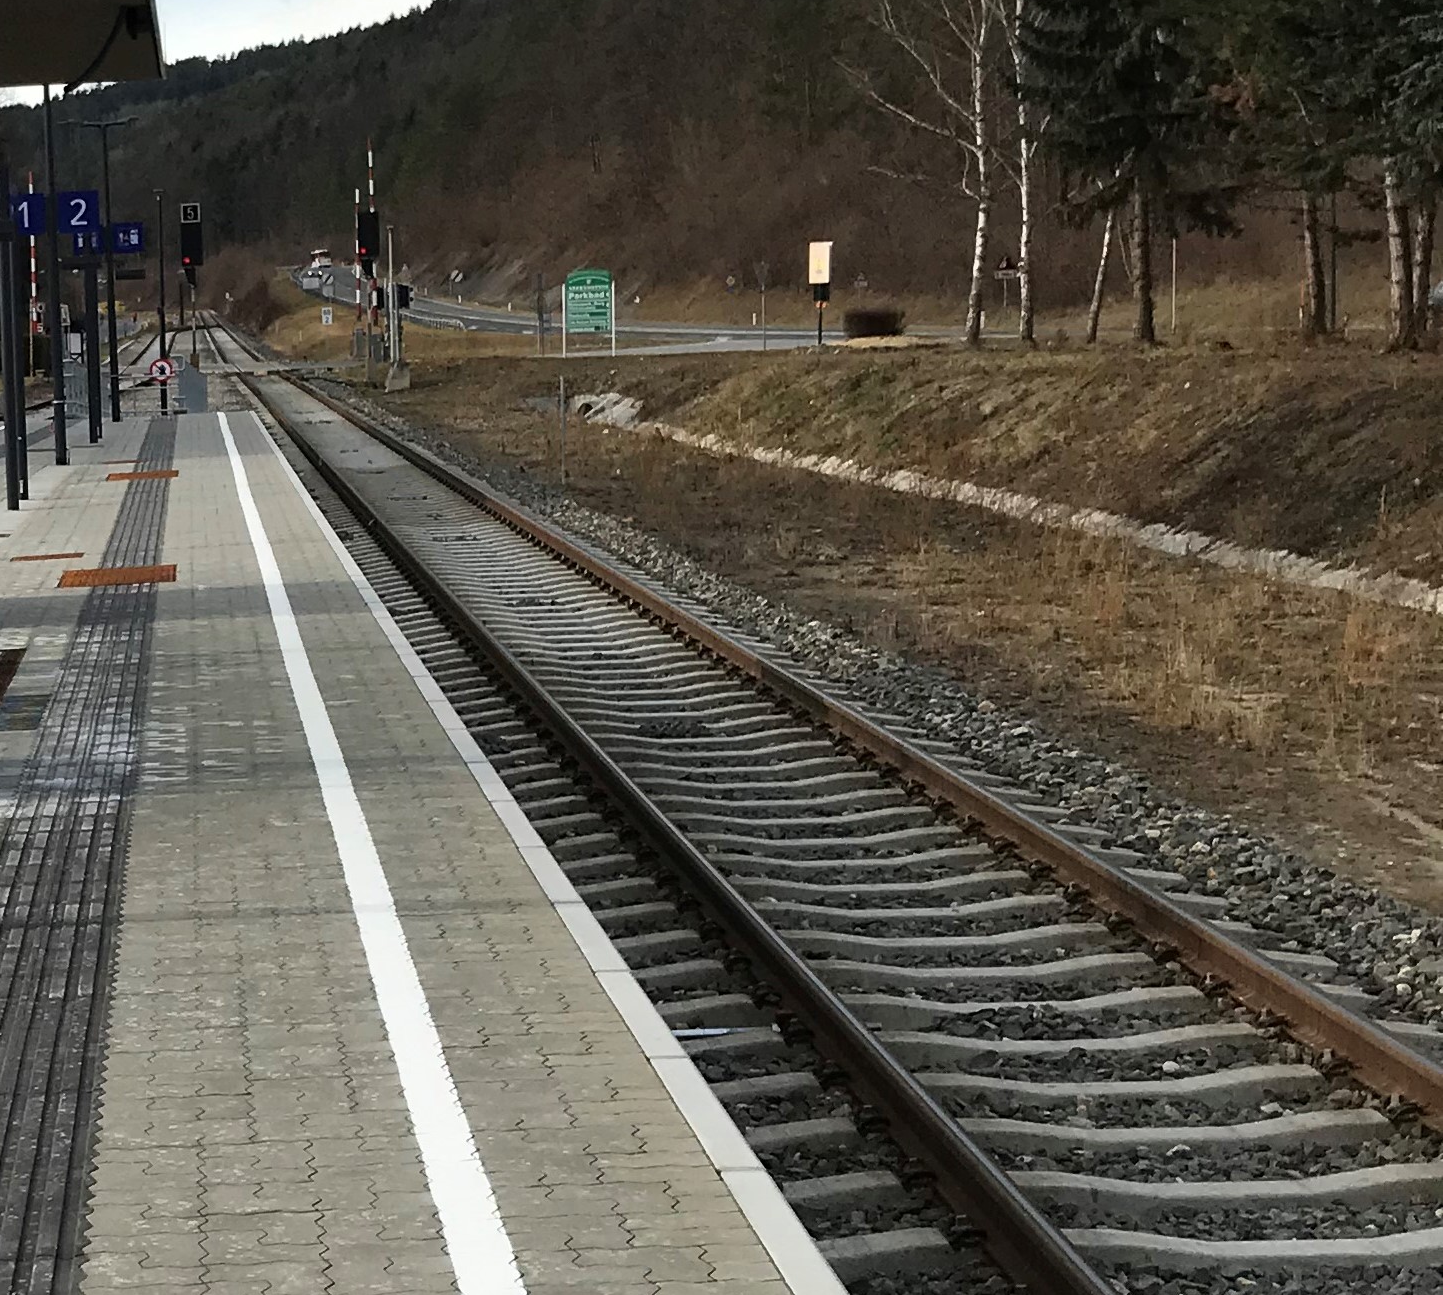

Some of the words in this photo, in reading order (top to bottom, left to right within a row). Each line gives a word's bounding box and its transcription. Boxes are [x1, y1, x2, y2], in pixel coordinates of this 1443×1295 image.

[18, 201, 29, 228] 1
[70, 198, 88, 226] 2
[187, 206, 194, 220] 5
